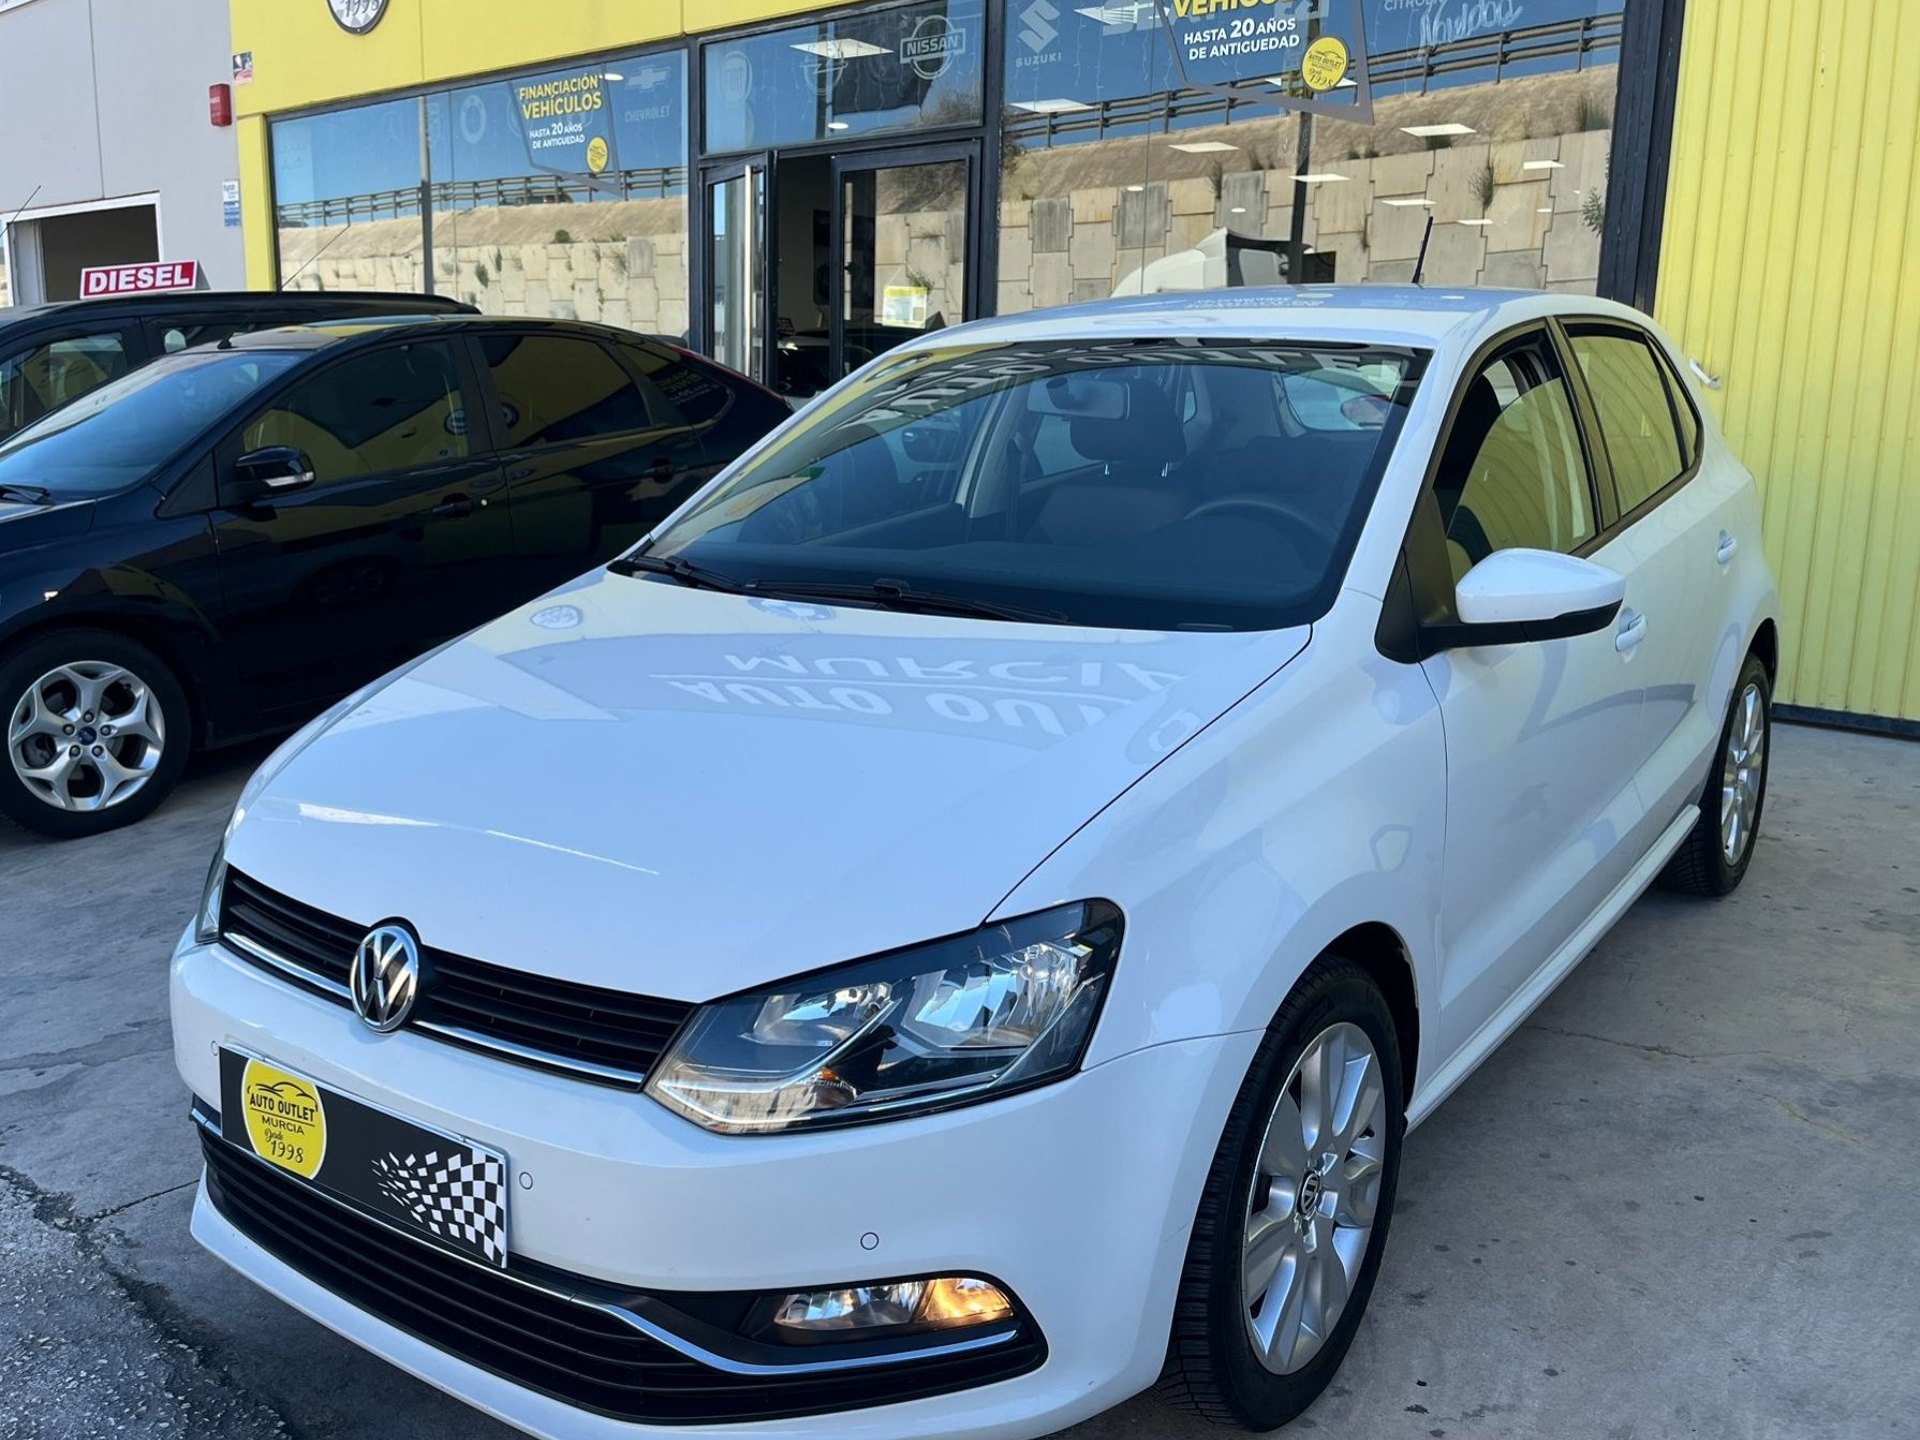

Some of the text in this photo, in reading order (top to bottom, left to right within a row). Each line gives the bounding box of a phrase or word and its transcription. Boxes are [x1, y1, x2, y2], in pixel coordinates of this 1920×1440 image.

[1183, 17, 1296, 45] HASTA 20 AÑOS
[907, 34, 959, 56] NISSAN
[1188, 34, 1300, 60] DE ANTIGUEDAD
[1015, 52, 1062, 68] SUZUKI
[519, 73, 598, 101] FINANCIACIÓN
[522, 92, 602, 120] VEHÍCULOS
[624, 105, 671, 123] CHEVROLET
[529, 121, 583, 139] HASTA 20 AÑOS
[532, 140, 542, 150] DE
[88, 265, 190, 293] DIESEL
[249, 1093, 315, 1122] AUTO OUTLET
[261, 1115, 305, 1135] MURCIA
[270, 1140, 304, 1164] 1998
